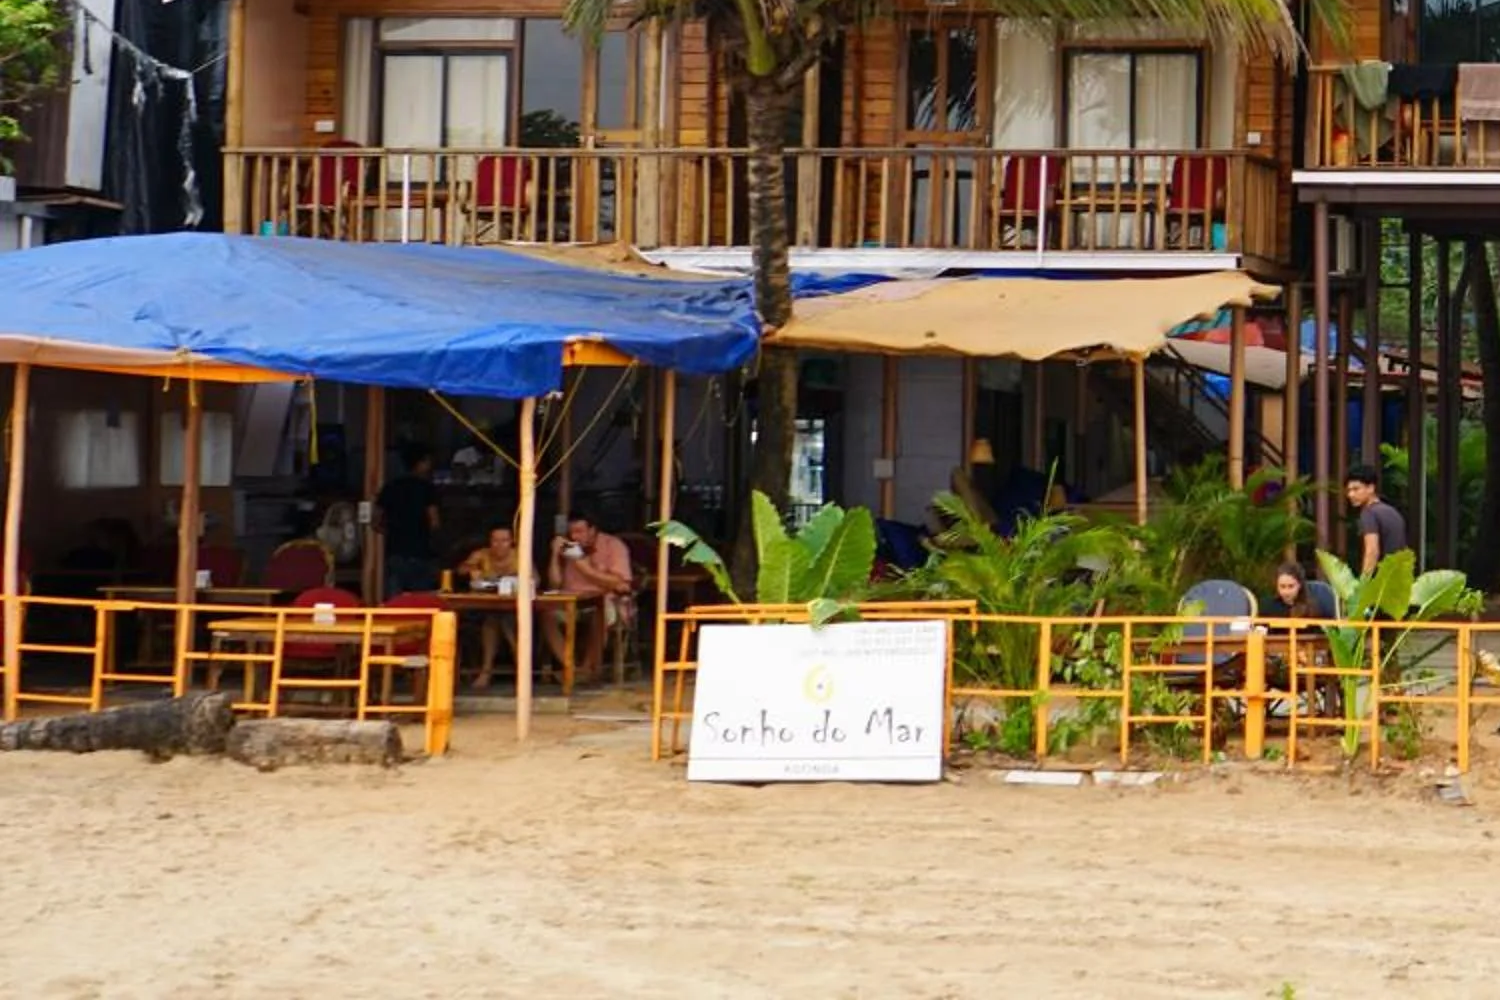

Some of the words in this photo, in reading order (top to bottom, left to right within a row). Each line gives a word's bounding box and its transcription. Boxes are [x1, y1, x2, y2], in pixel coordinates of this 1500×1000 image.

[703, 708, 795, 747] Sonho
[812, 708, 847, 743] do
[864, 706, 925, 744] Mar
